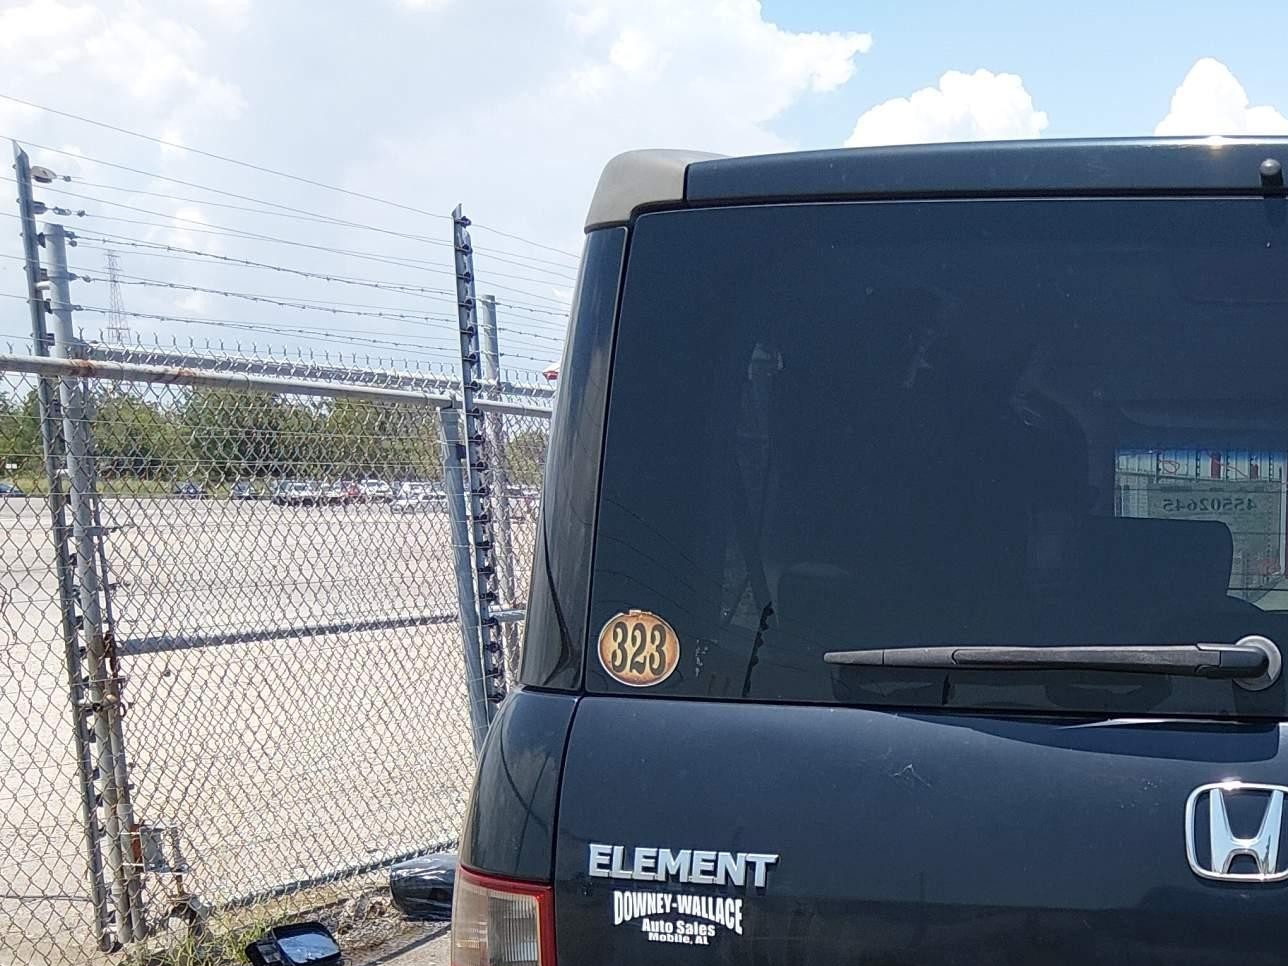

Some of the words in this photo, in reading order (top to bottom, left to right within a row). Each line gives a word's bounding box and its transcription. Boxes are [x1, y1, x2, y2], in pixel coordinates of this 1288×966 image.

[611, 621, 666, 676] 323
[589, 844, 779, 887] ELEMENT
[613, 891, 743, 934] DOWNEY-WALLACE
[641, 918, 674, 933] Auto
[676, 920, 716, 936] Sales
[648, 932, 693, 945] Mobile,
[695, 935, 709, 945] AL
